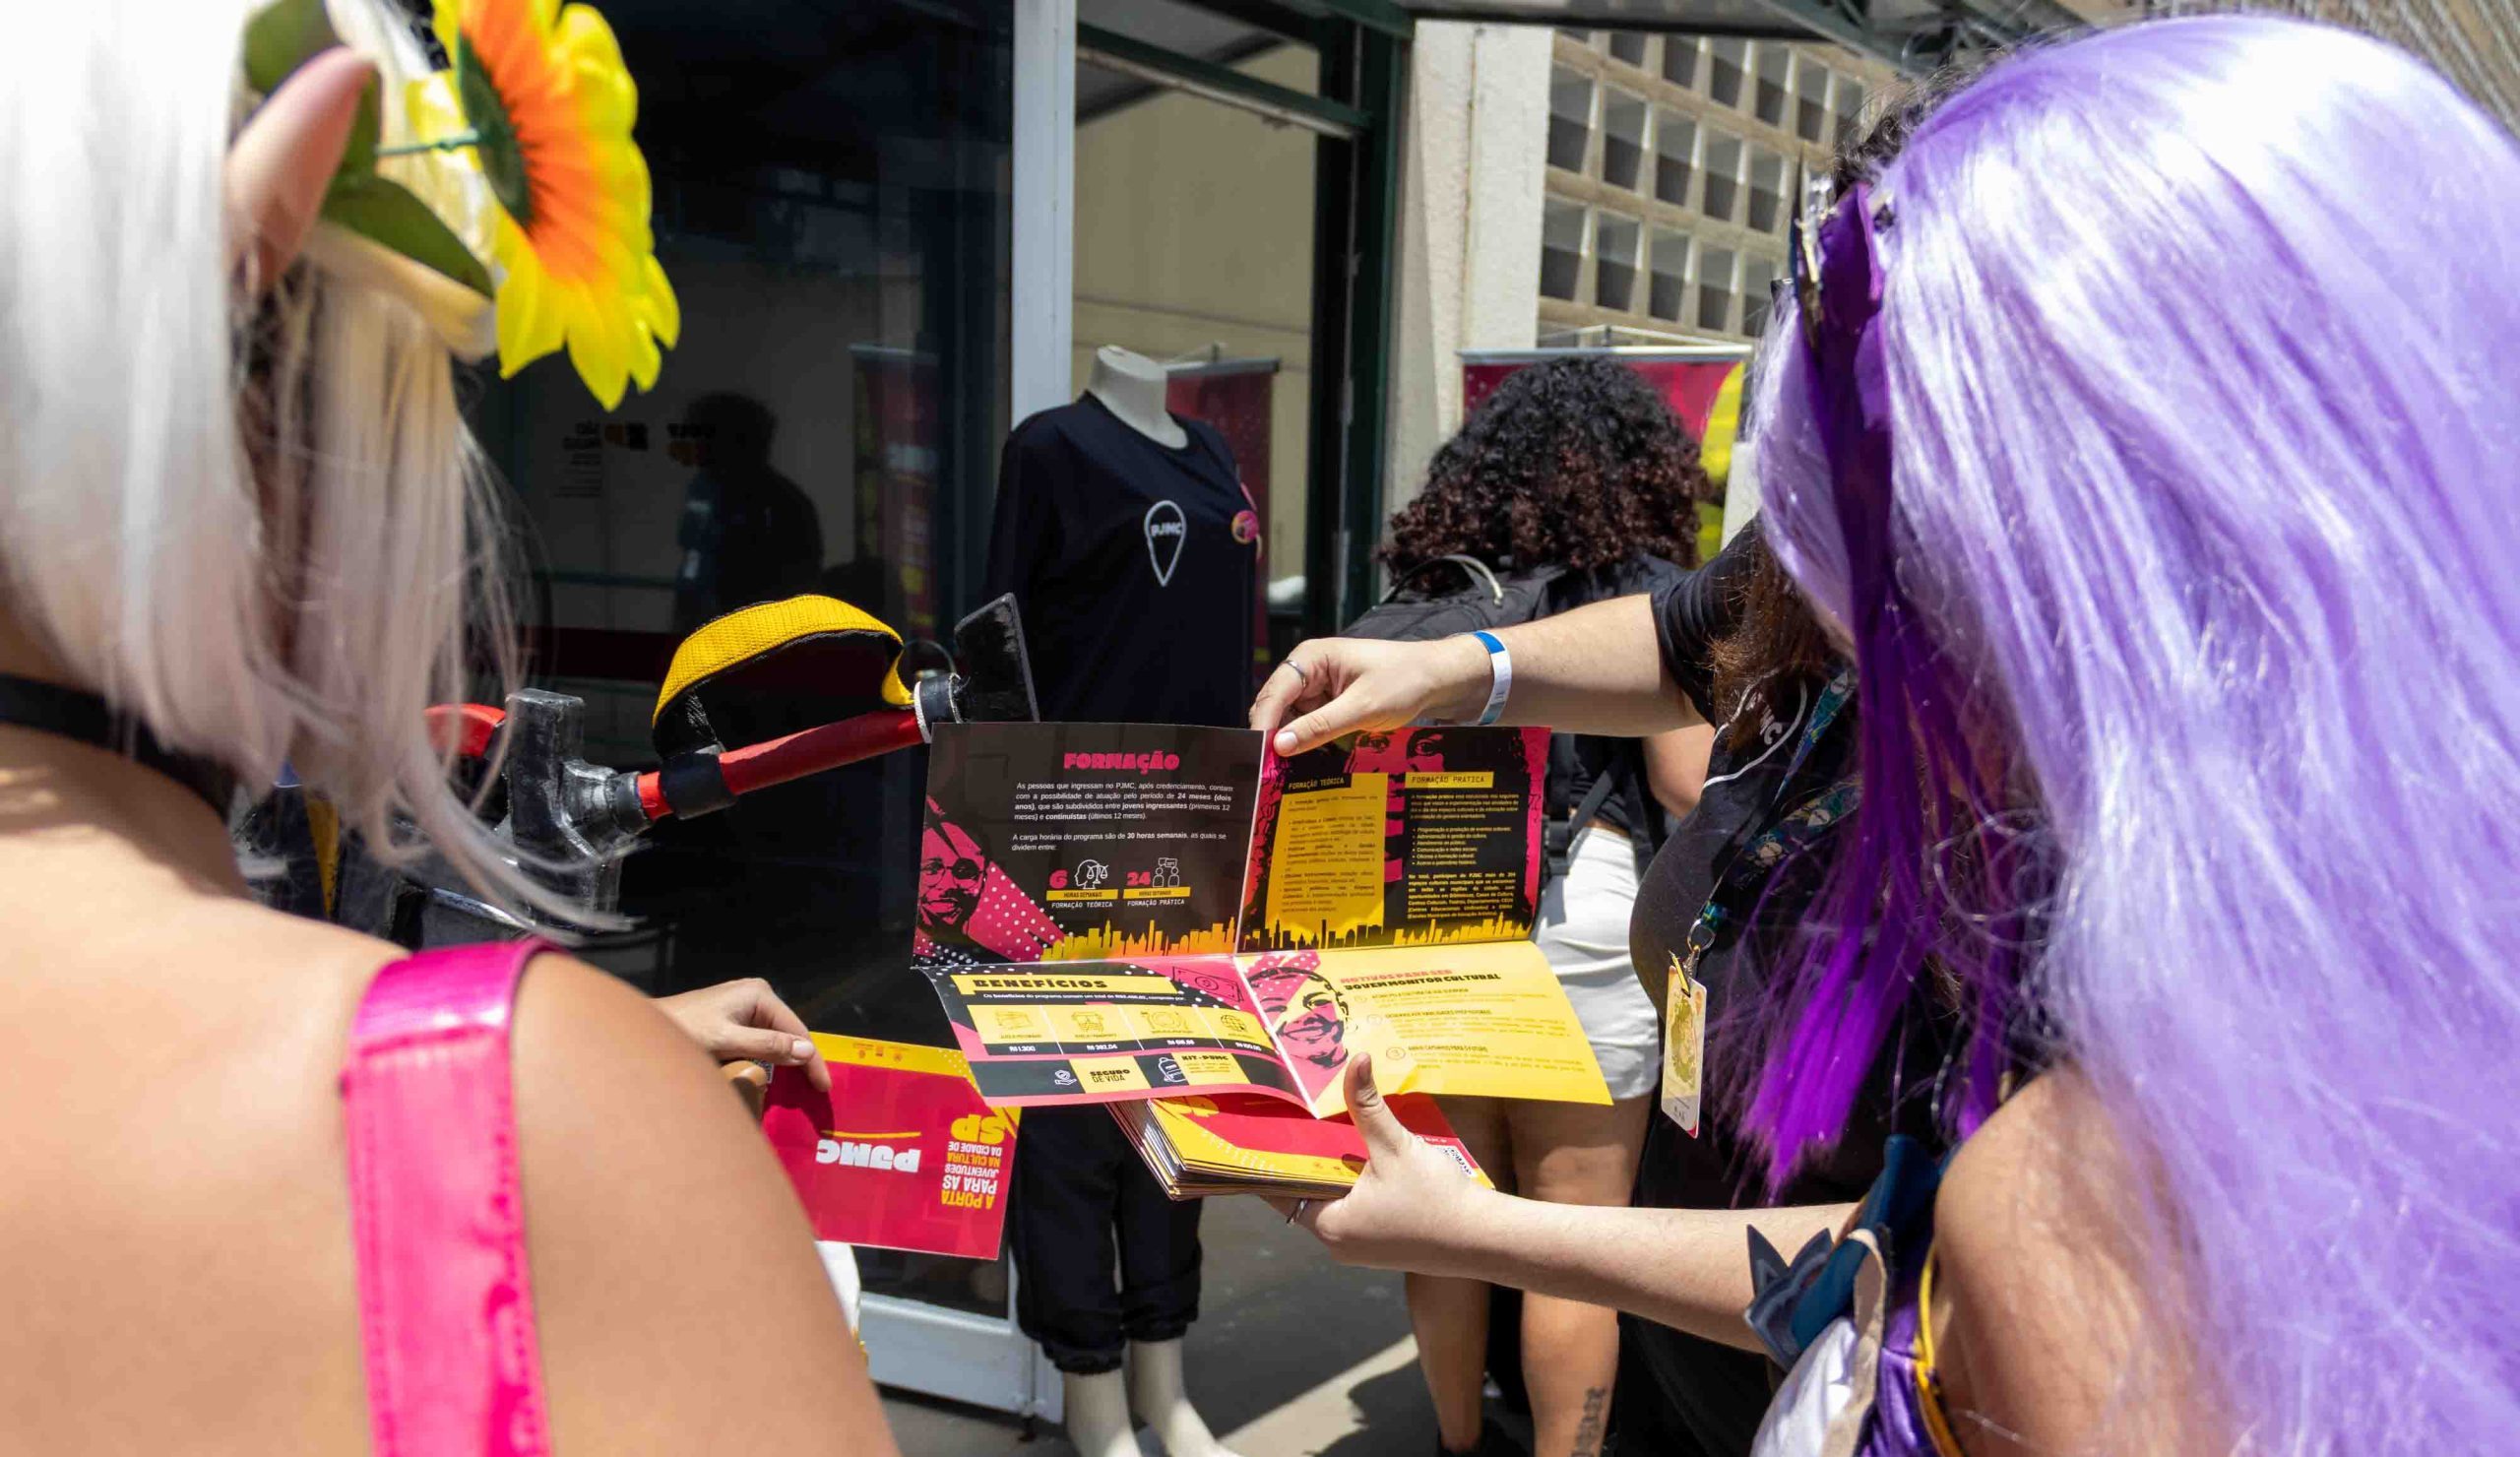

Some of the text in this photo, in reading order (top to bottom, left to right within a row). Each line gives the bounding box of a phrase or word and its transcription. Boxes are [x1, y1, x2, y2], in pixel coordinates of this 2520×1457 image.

[1064, 750, 1179, 775] FORMAÇÃO
[1289, 779, 1318, 790] FORMAÇÃO
[1412, 775, 1449, 785] FORMAÇÃO
[1049, 869, 1069, 889] 6
[1126, 871, 1151, 886] 24
[1051, 901, 1083, 910] FORMAÇÃO
[1127, 899, 1156, 908] FORMAÇÃO
[973, 978, 1108, 988] BENEFÍCIOS
[1340, 974, 1395, 983] MOTIVOS
[1344, 973, 1501, 990] JOVEM MONITOR CULTURAL
[951, 1113, 1005, 1145] SP
[816, 1140, 920, 1172] PJMC
[948, 1141, 1003, 1157] DA CIDADE DE
[946, 1152, 1001, 1168] NA CULTURA
[944, 1164, 1000, 1178] JUVENTUDES
[942, 1174, 998, 1194] PARA AS
[941, 1189, 995, 1210] A PORTA
